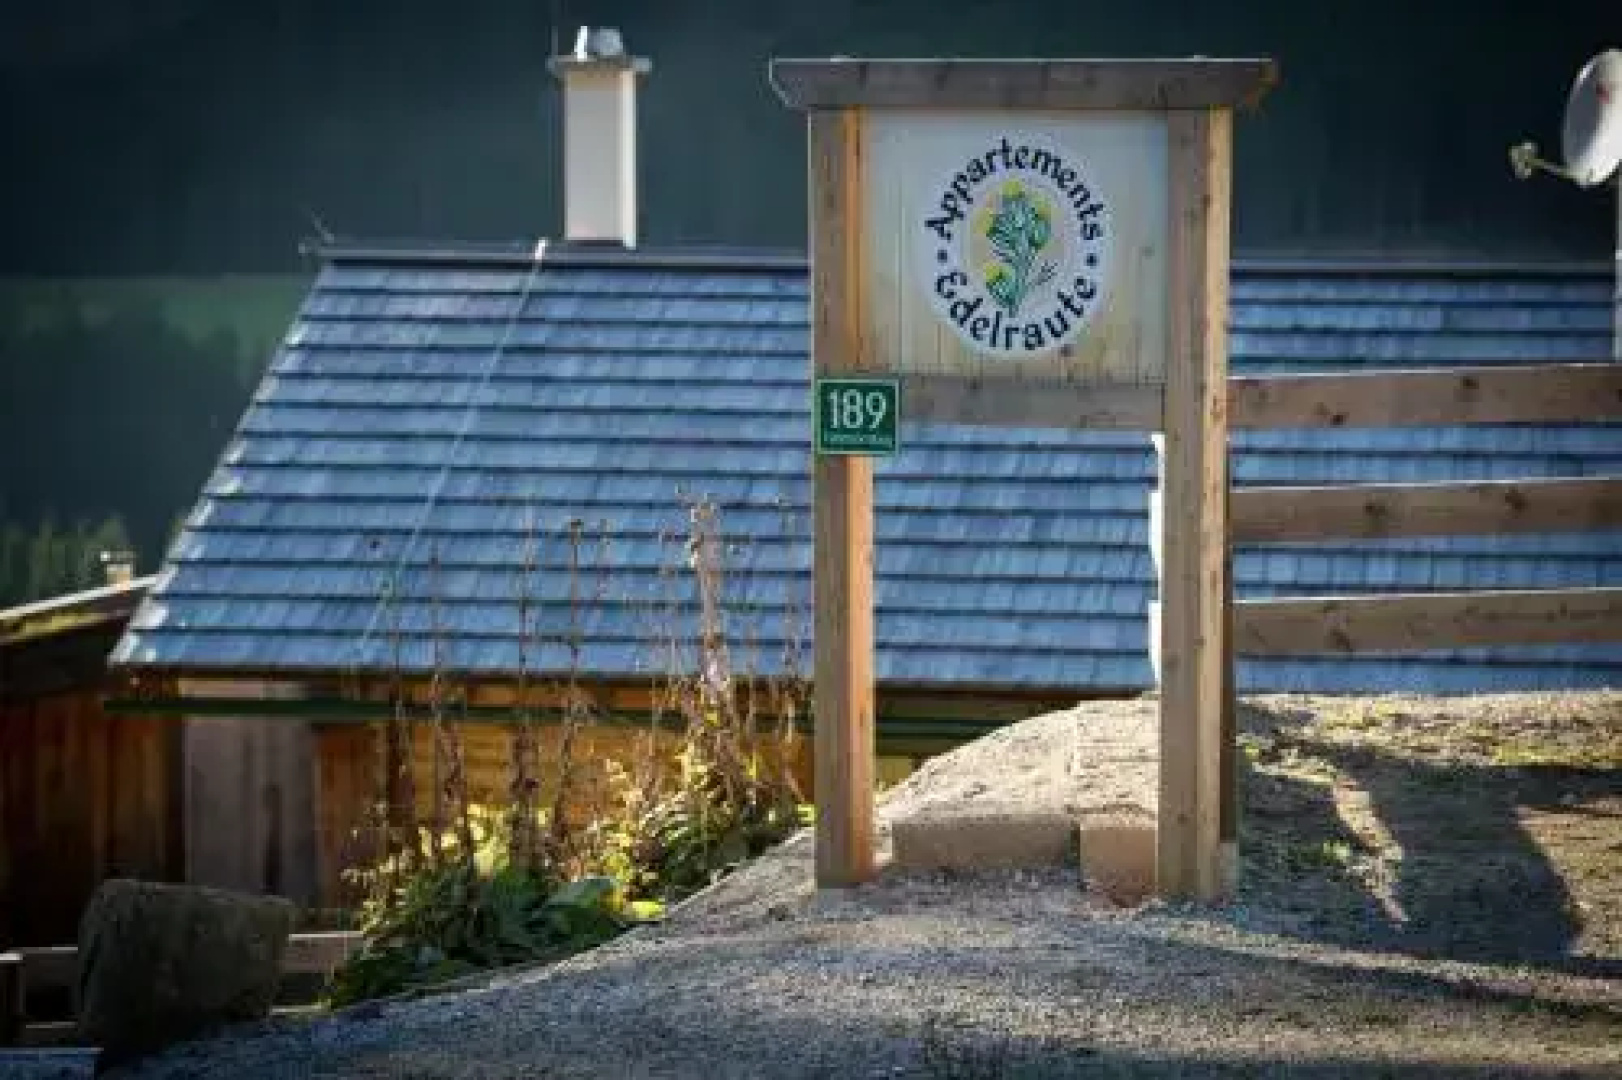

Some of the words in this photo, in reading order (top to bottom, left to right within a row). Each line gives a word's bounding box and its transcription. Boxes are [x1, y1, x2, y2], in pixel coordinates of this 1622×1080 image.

[924, 138, 1104, 241] Appartements
[935, 272, 1097, 350] Edelraute
[828, 389, 887, 430] 189
